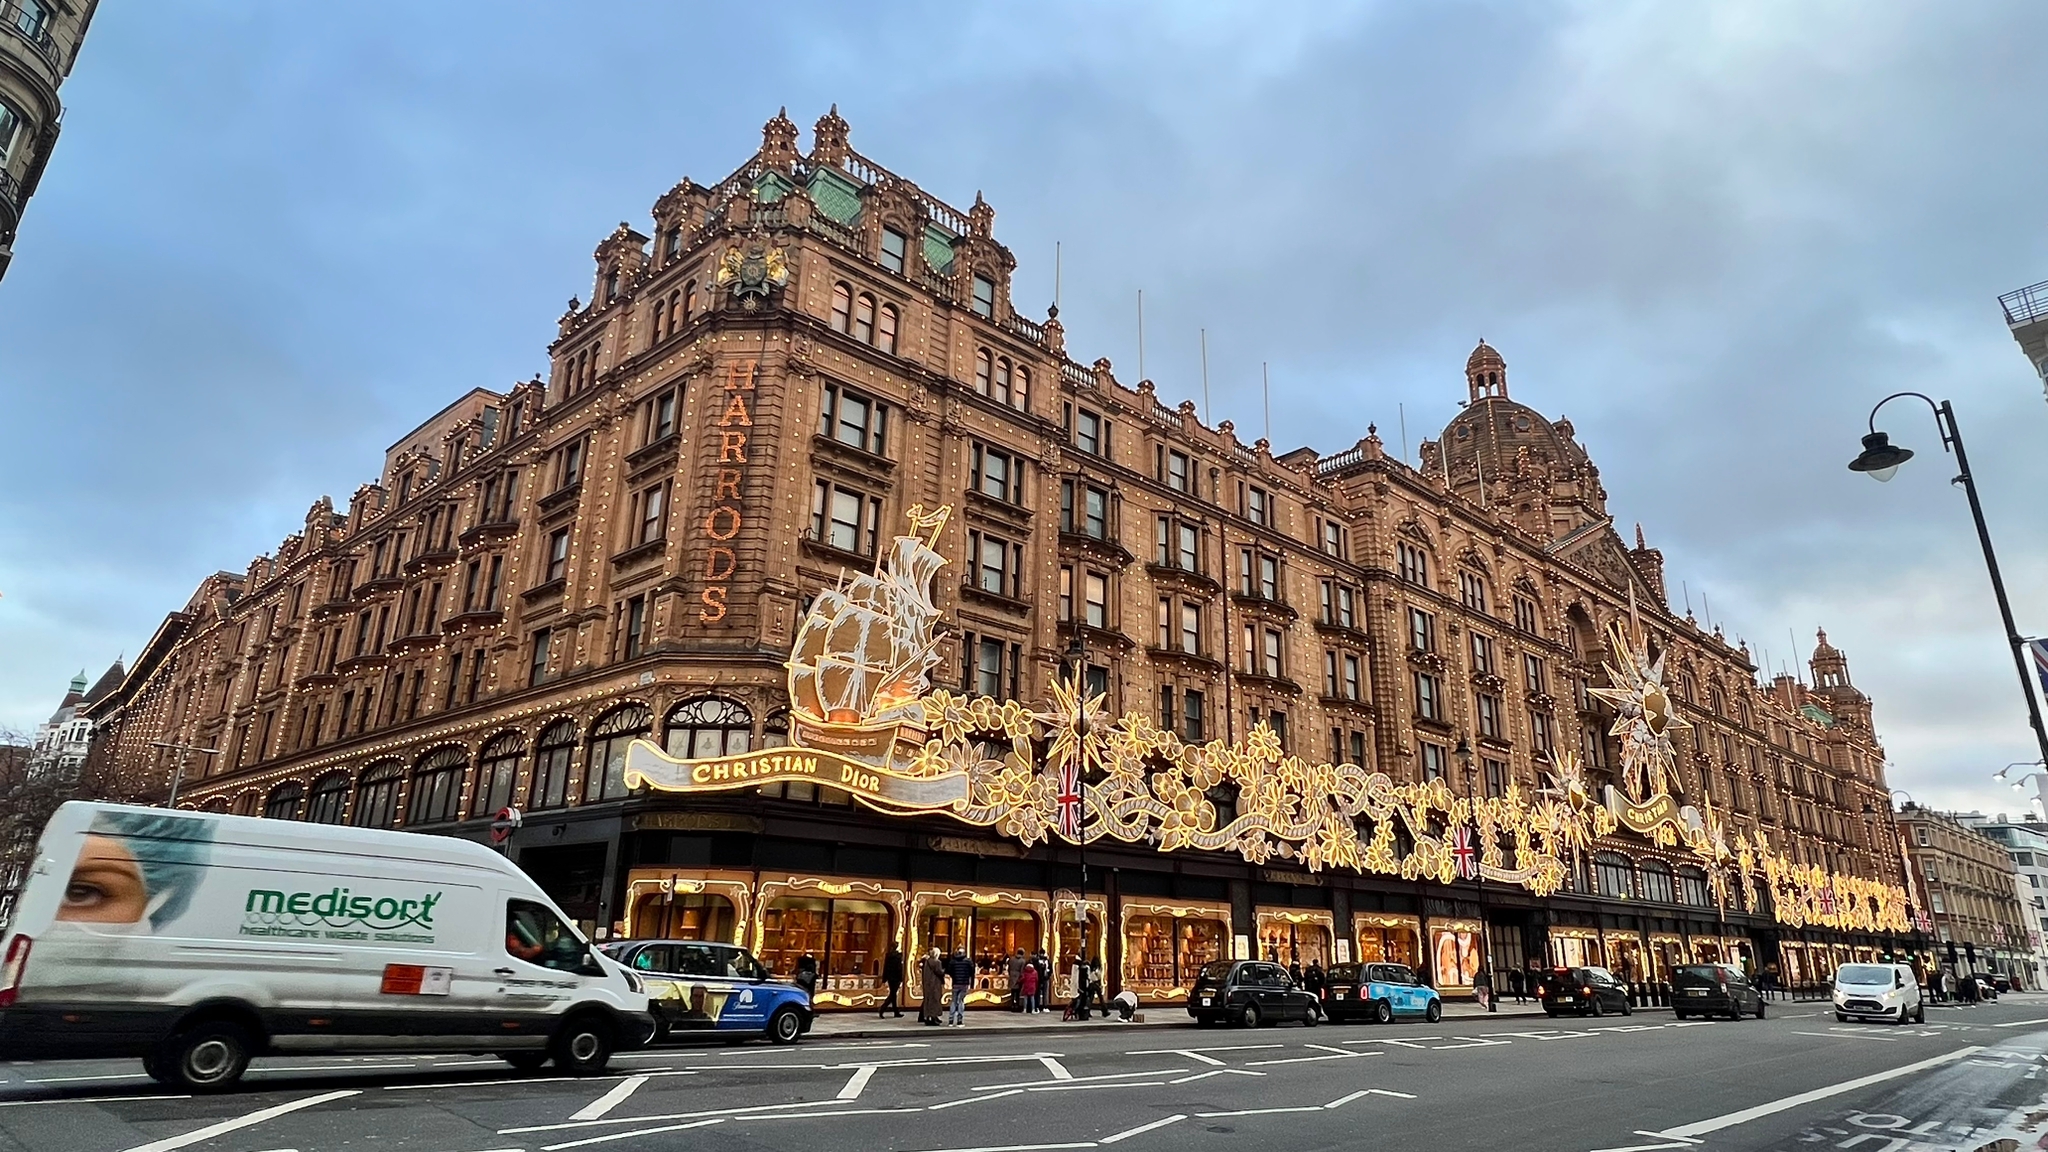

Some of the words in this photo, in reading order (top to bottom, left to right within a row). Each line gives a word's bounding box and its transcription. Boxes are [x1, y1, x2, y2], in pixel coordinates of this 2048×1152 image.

[700, 359, 757, 622] HARRODS
[692, 755, 818, 783] CHRISTIAN
[840, 764, 881, 792] DIOR
[245, 887, 442, 923] medisort
[239, 924, 320, 939] healthcare
[325, 930, 369, 941] waste
